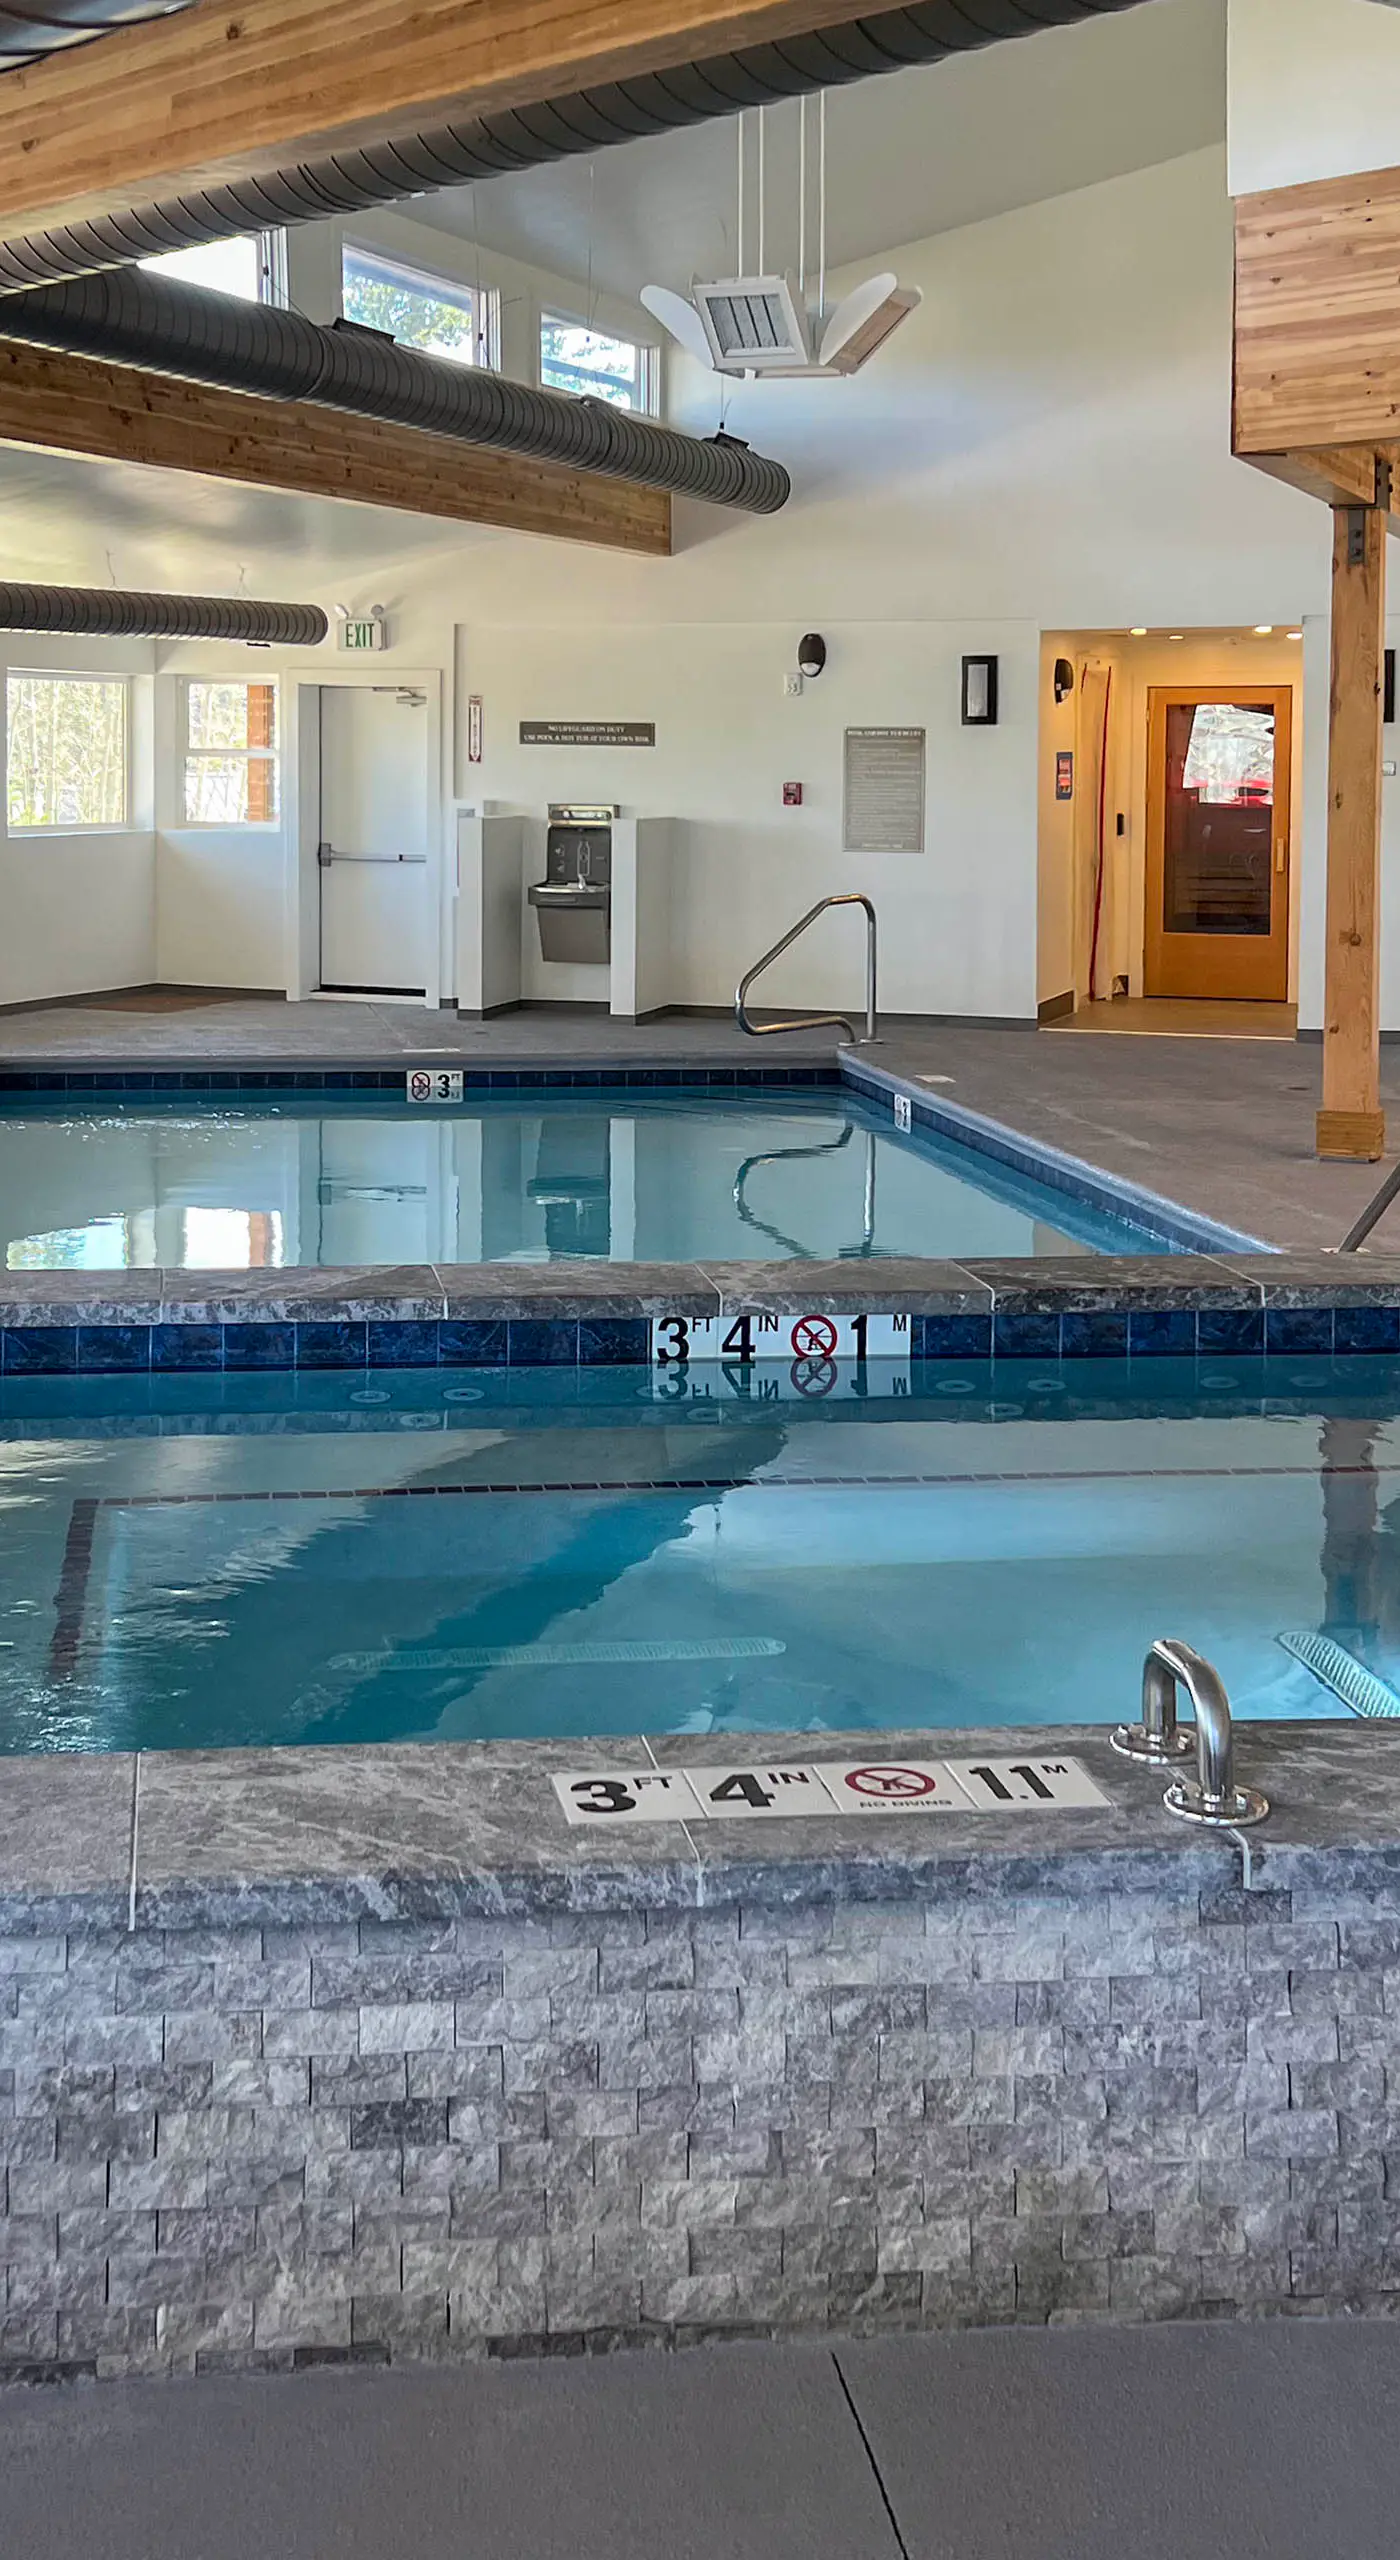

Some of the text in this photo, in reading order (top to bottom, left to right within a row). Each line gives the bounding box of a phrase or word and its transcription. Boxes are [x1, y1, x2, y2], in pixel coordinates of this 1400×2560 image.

[345, 623, 375, 648] EXIT
[657, 1314, 907, 1362] 3 FT 4 IN 1 M
[570, 1764, 1069, 1813] 3 FT 4 IN 1.1 M
